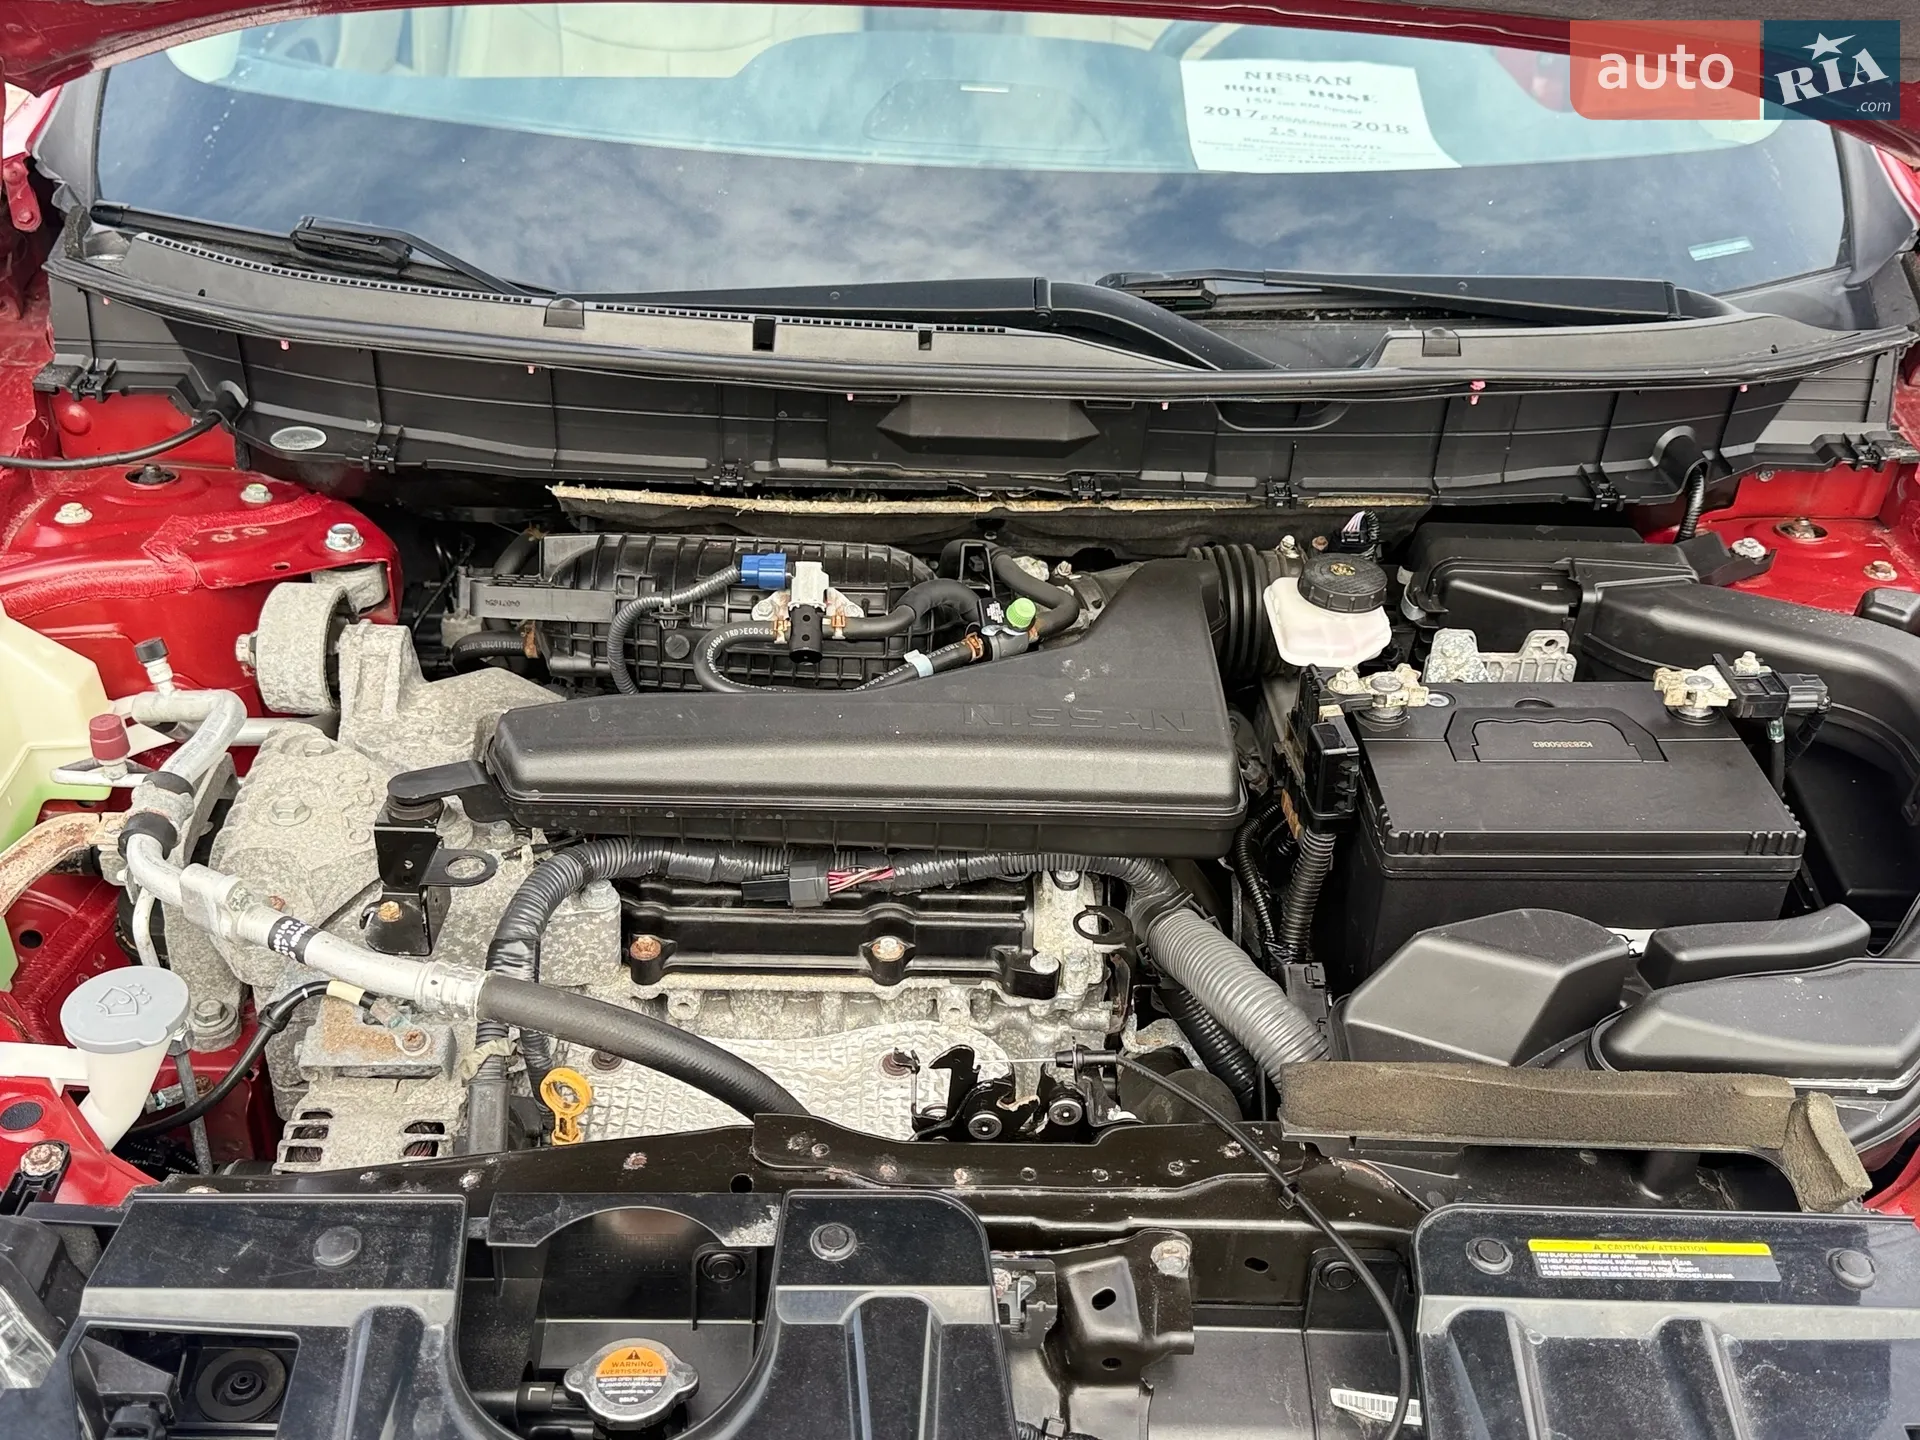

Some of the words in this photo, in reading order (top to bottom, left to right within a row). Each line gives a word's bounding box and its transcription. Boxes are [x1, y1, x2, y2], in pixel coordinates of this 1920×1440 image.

[1244, 71, 1352, 86] NISSAN
[1351, 120, 1409, 135] 2018
[963, 704, 1195, 732] NISSAN
[1607, 1243, 1649, 1251] CAUTION
[1658, 1244, 1708, 1252] ATTENTION
